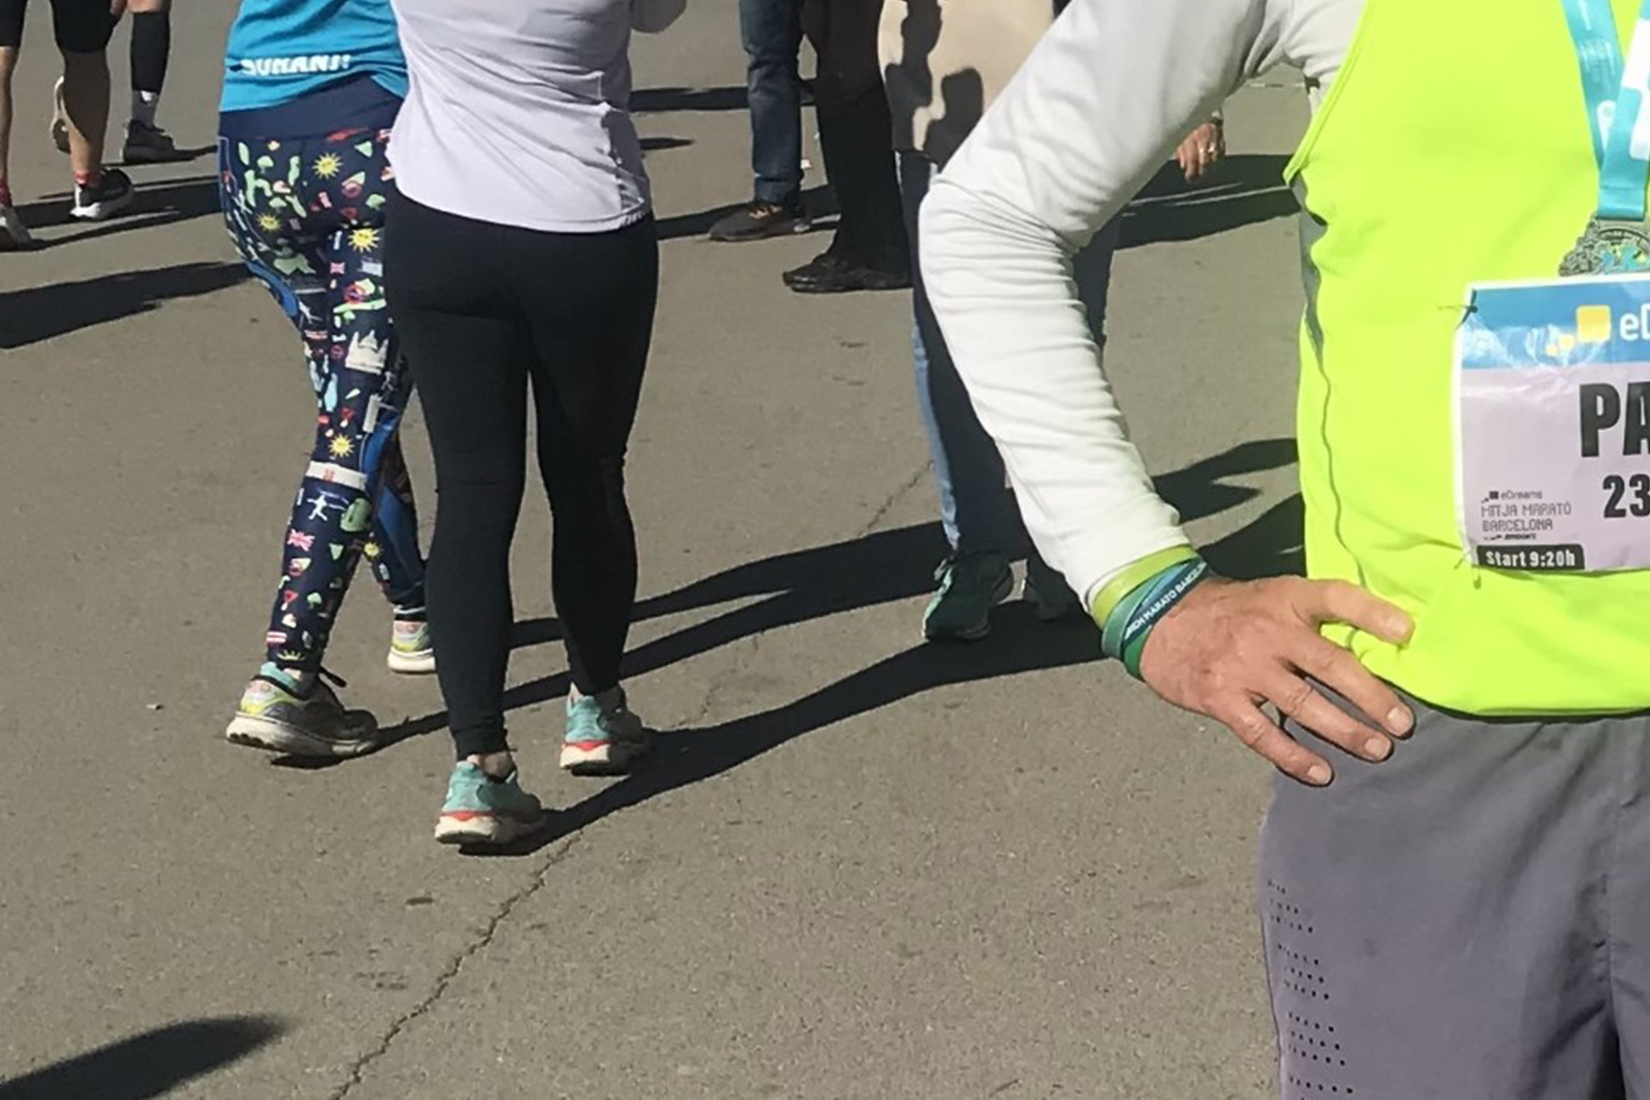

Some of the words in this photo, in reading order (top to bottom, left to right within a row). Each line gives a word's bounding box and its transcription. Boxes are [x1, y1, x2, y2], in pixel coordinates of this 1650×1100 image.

[1482, 518, 1553, 532] BARCELONA
[1485, 550, 1527, 567] Start
[1529, 549, 1576, 567] 9:20h
